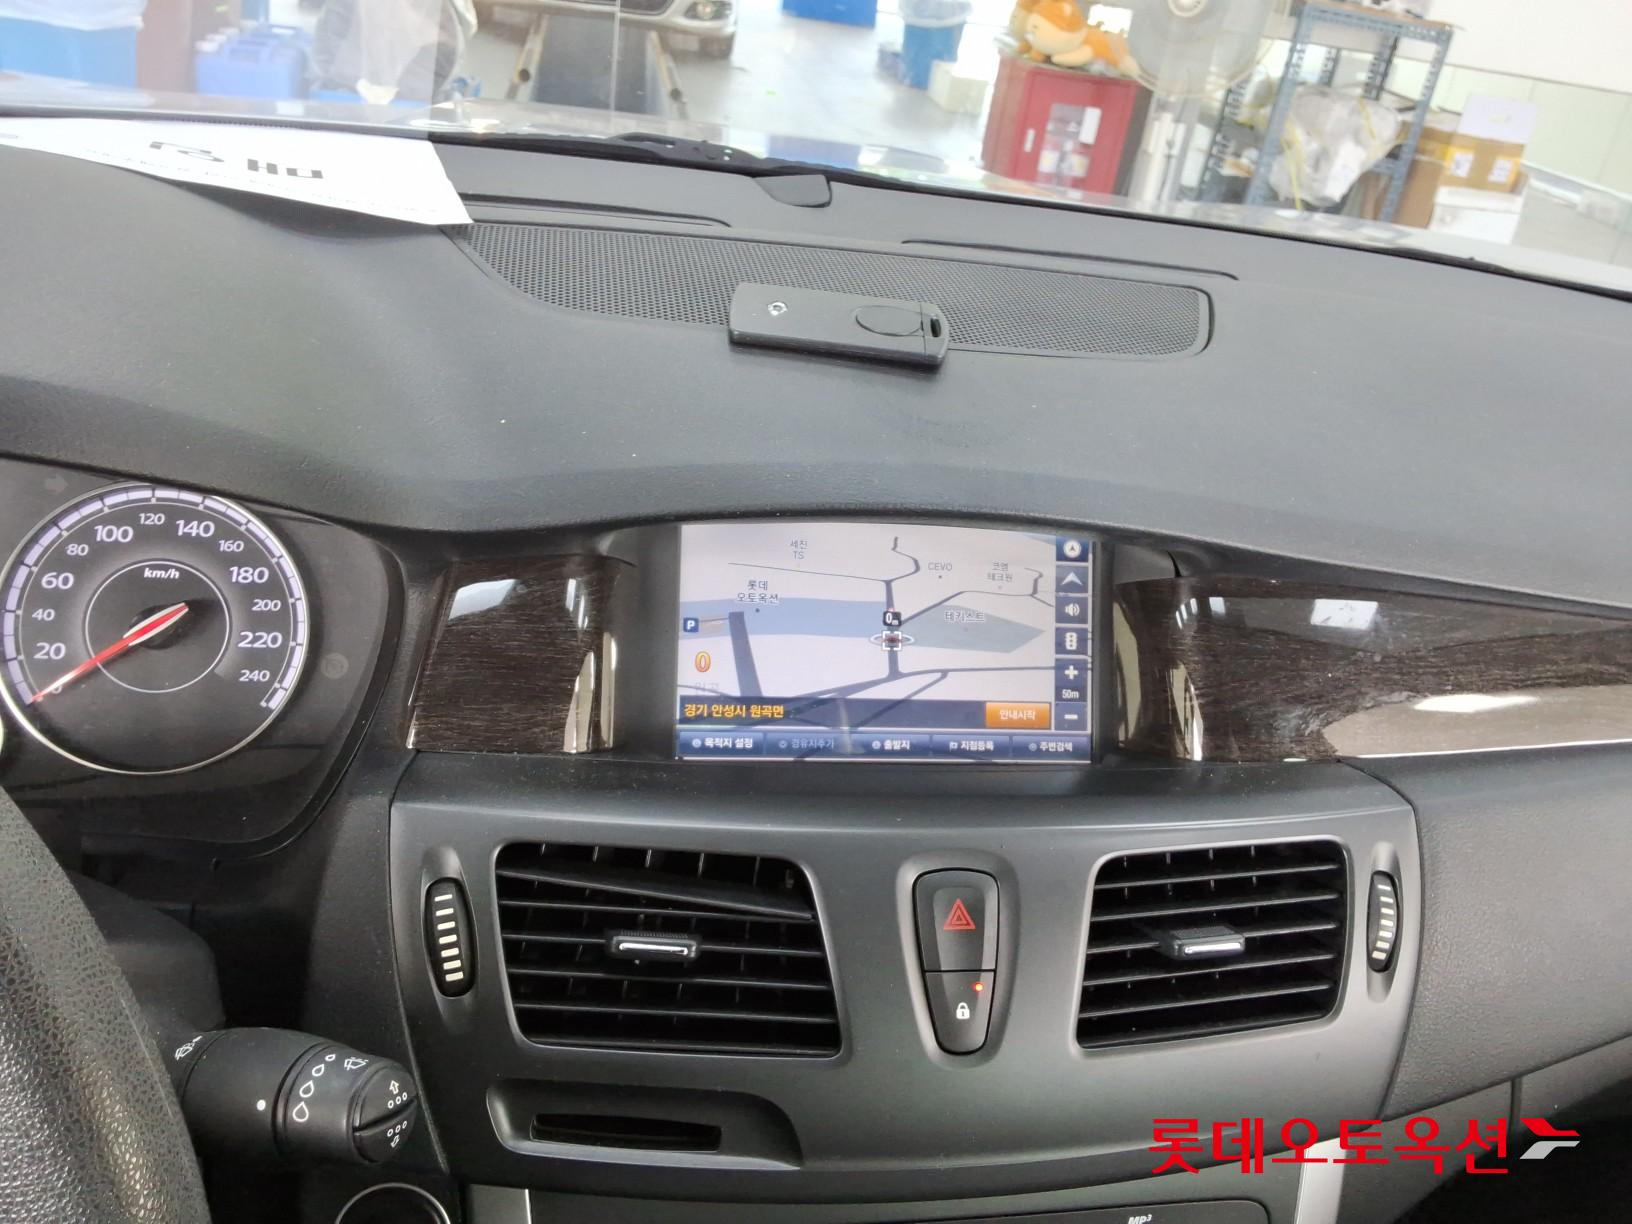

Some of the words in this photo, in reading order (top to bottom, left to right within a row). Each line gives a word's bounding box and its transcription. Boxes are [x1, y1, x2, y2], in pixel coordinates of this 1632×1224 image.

[139, 513, 165, 525] 120
[94, 525, 134, 543] 100
[176, 520, 215, 538] 140
[66, 543, 89, 557] 80
[218, 540, 244, 553] 160
[793, 551, 805, 560] TS
[928, 562, 953, 571] CEVO
[41, 572, 74, 590] 60
[143, 567, 180, 581] km/h
[229, 566, 269, 584] 180
[747, 580, 769, 591] 롯데
[251, 599, 281, 612] 200
[737, 593, 779, 604] 오토옥션
[31, 608, 55, 622] 40
[237, 631, 282, 648] 220
[34, 642, 66, 660] 20
[695, 651, 711, 672] 0
[239, 670, 270, 682] 240
[1062, 689, 1079, 699] 50m
[684, 704, 707, 717] 경기
[711, 704, 746, 718] 안성시
[750, 705, 784, 718] 원곡면
[704, 737, 732, 749] 목적지
[735, 737, 753, 749] 설정
